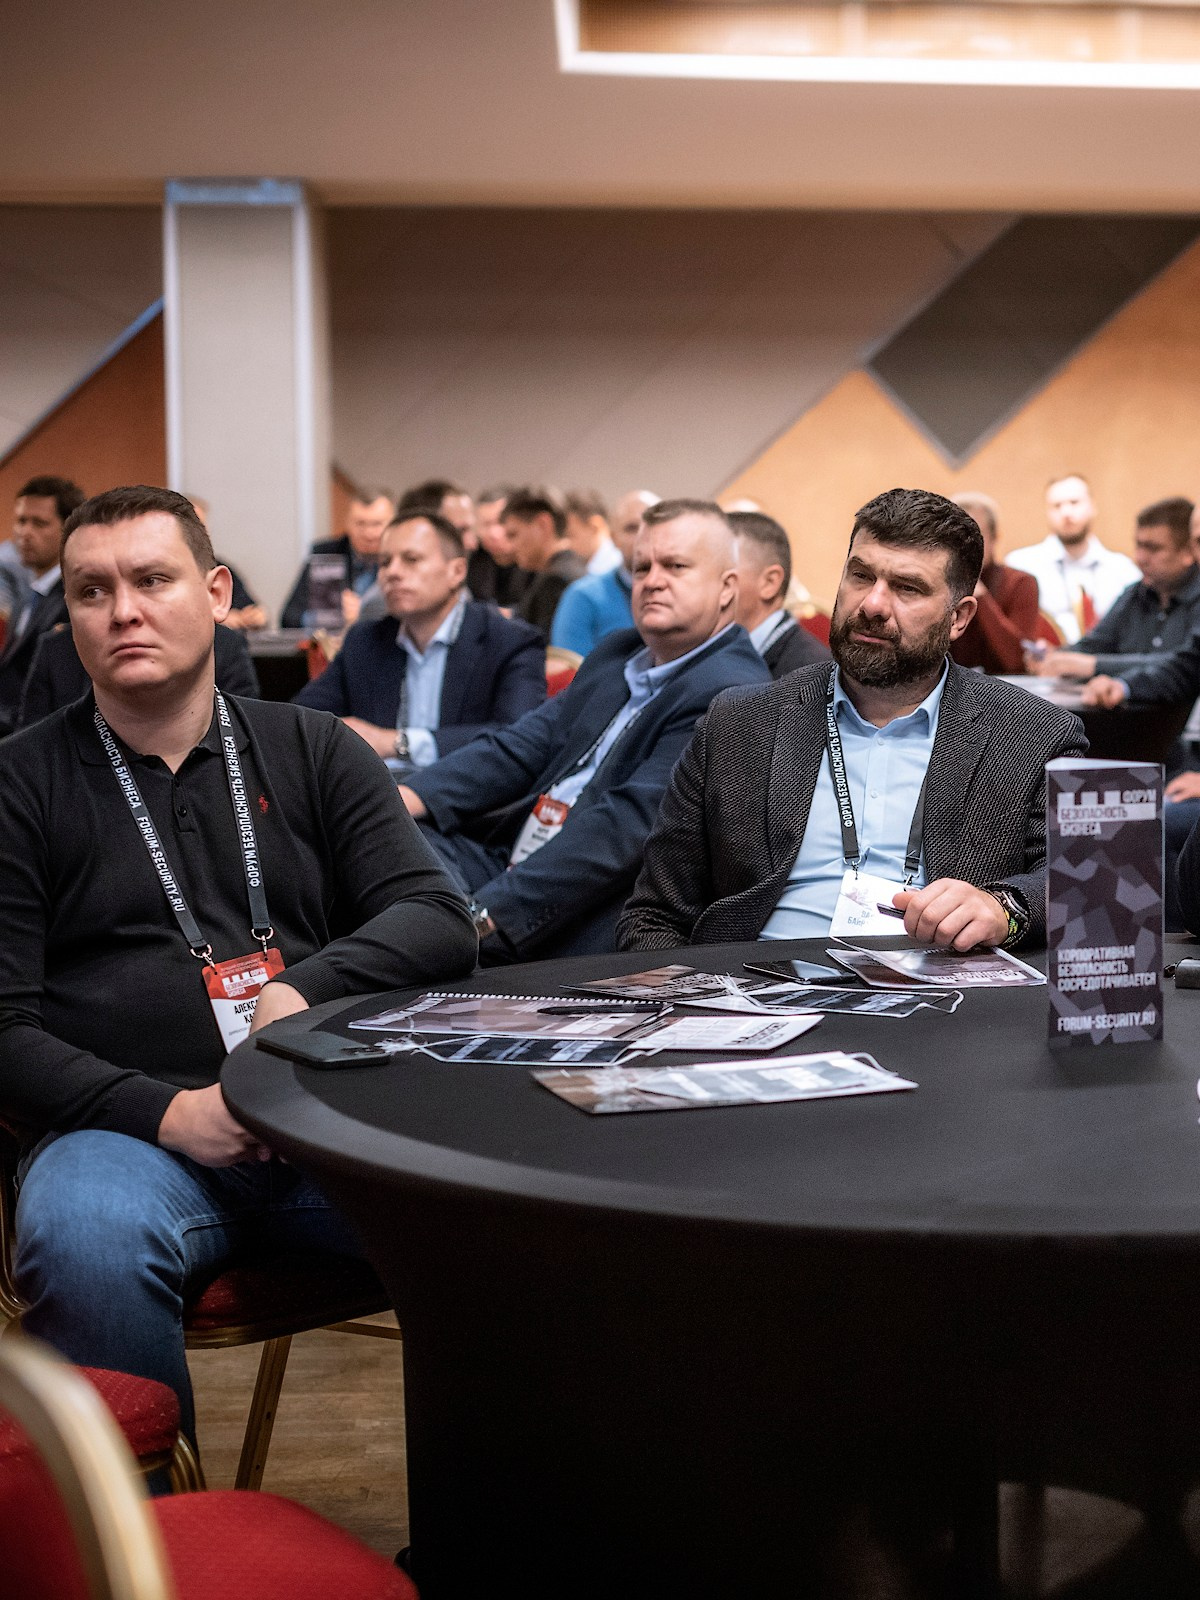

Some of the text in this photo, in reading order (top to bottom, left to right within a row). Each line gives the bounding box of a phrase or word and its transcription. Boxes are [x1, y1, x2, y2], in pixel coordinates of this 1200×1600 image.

[827, 703, 839, 737] БИЗНЕСА
[224, 736, 241, 777] БИЗНЕСА
[830, 738, 849, 797] БЕЗОПАСНОСТЬ
[1122, 789, 1156, 803] ФОРУМ
[94, 708, 186, 912] ОПАСНОСТЬ БИЗНЕСА FORUM-SECURITY.RU
[231, 778, 255, 849] БЕЗОПАСНОСТЬ
[840, 797, 853, 828] ФОРУМ
[1061, 806, 1128, 820] БЕЗОПАСНОСТЬ
[1060, 822, 1101, 836] БИЗНЕСА
[245, 849, 260, 888] ФОРУМ
[1058, 945, 1135, 962] КОРПОРАТИВНАЯ
[1058, 960, 1128, 977] БЕЗОПАСНОСТЬ
[234, 1000, 258, 1014] АЛЕКС
[1058, 1011, 1155, 1032] FORUM-SECURITY.RU
